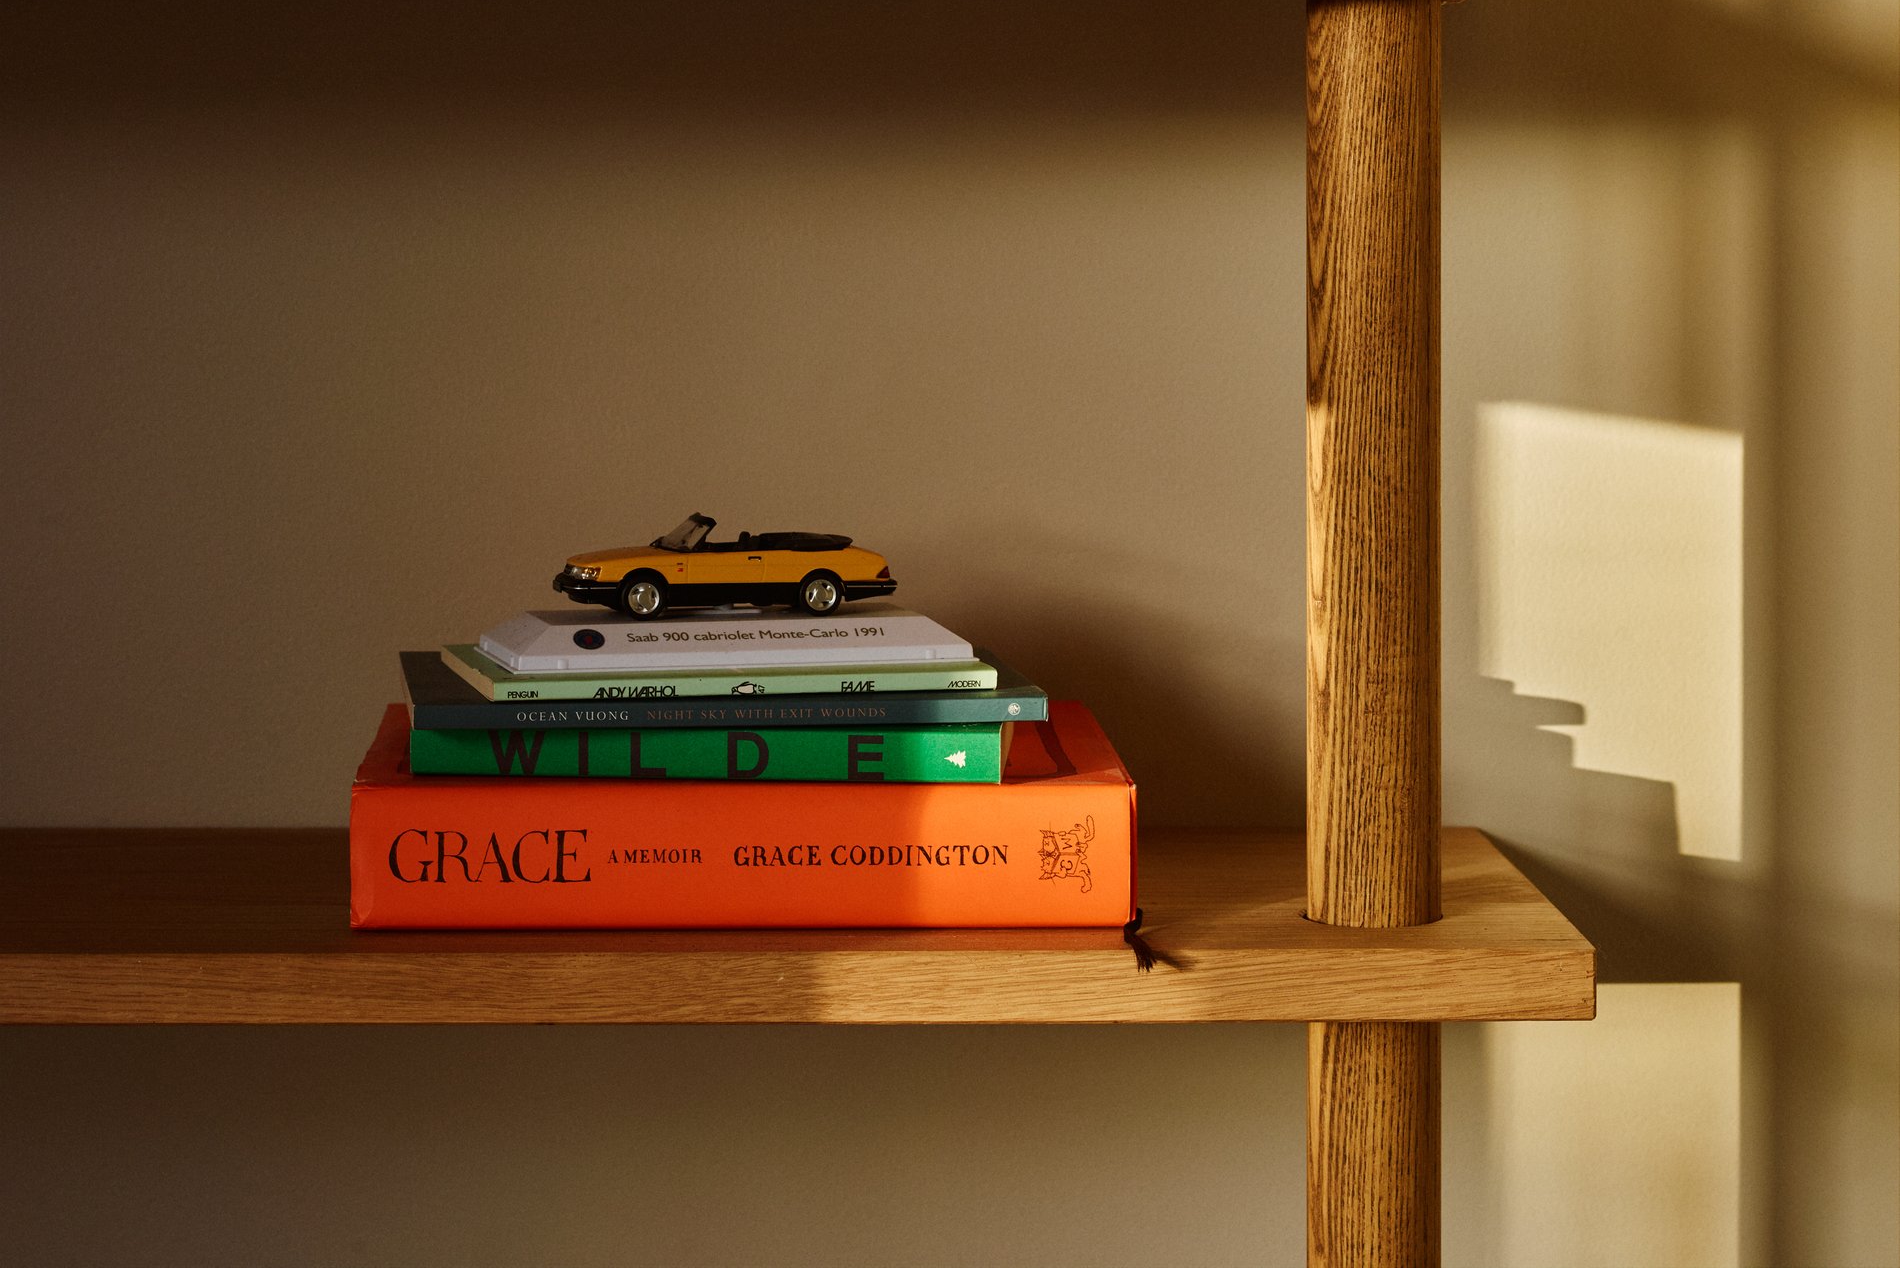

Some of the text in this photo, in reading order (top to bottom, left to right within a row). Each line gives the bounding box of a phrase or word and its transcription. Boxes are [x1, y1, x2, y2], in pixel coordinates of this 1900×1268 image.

[626, 627, 885, 643] Saab 900 cabriolet Monte-Carlo 1991
[841, 681, 875, 692] FAME
[947, 680, 981, 688] MODERN
[507, 691, 539, 699] PENGUIN
[593, 685, 680, 699] ANDY WARHOL
[516, 711, 629, 722] OCEAN VUONG
[647, 708, 886, 720] NIGHT SKY WITH EXIT WOUNDS
[487, 731, 885, 780] WILDE
[388, 828, 591, 883] GRACE
[607, 849, 703, 864] A MEMOIR
[733, 844, 1008, 867] GRACE CODDINGTON
